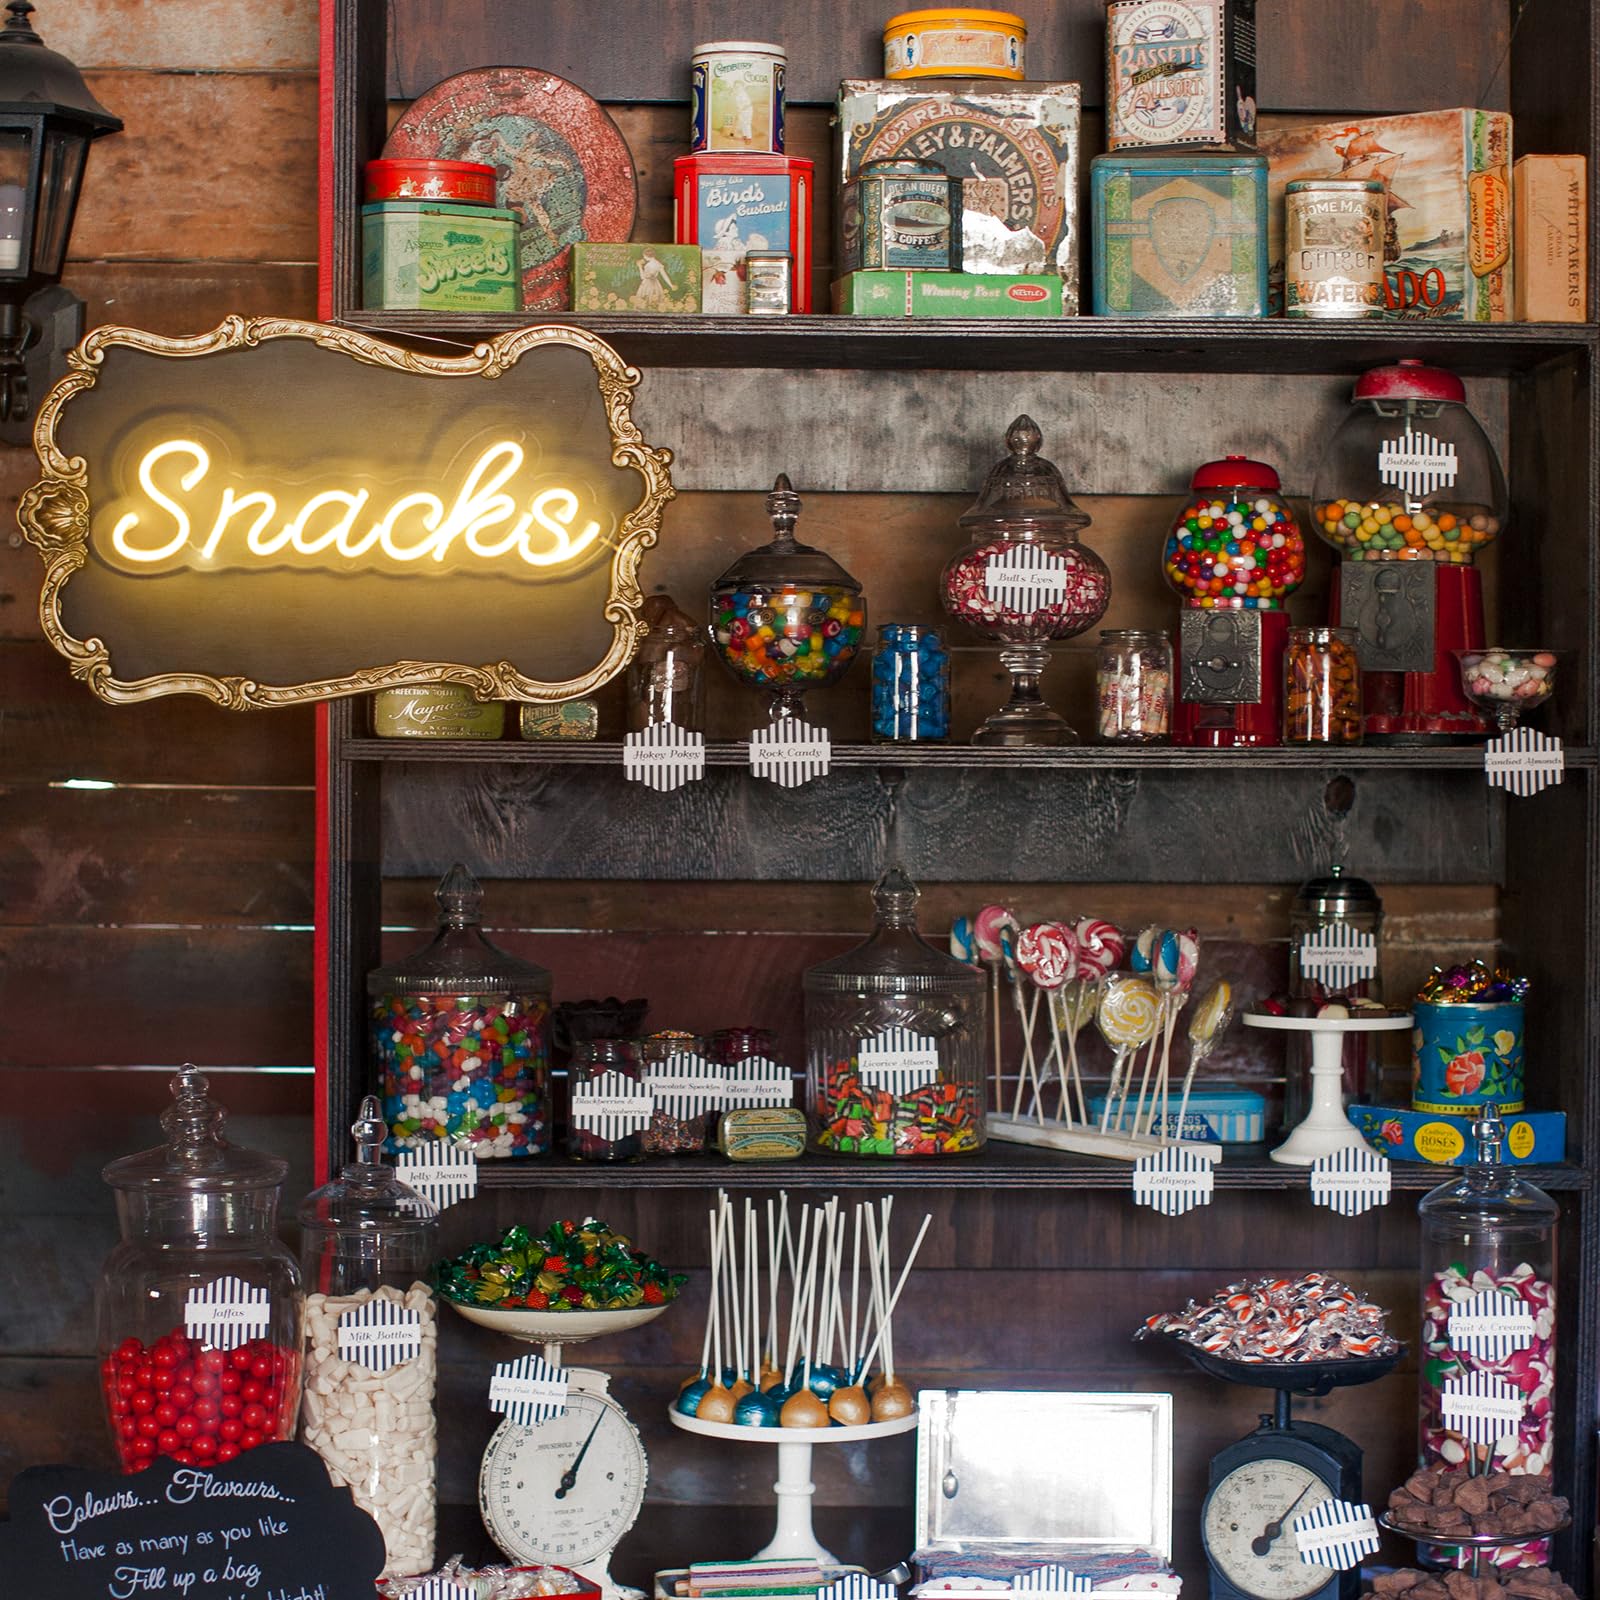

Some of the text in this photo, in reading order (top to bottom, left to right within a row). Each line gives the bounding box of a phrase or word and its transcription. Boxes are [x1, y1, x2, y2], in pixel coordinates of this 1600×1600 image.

[949, 125, 965, 148] &
[967, 127, 1034, 222] PALMERS
[706, 182, 764, 208] Bird's
[888, 182, 948, 195] OCEAN QUEEN
[736, 201, 788, 217] Custard!
[899, 234, 938, 246] COFFEE
[1567, 180, 1580, 308] WHITTAKERS
[416, 239, 510, 294] Sweets
[1301, 248, 1375, 272] Ginger
[921, 283, 1000, 300] Winning Post
[1296, 281, 1379, 304] WAFERS
[1385, 456, 1420, 466] Bubble
[111, 438, 602, 567] Snacks
[1030, 574, 1054, 585] Eyes
[633, 750, 701, 760] Hokey Pokey
[758, 747, 823, 759] Rock Candy
[862, 1059, 898, 1068] Licorice
[725, 1085, 750, 1094] Glow
[1421, 1135, 1457, 1147] ROSES
[410, 1171, 469, 1182] Jelly Beans
[1149, 1176, 1197, 1187] Lollipops
[212, 1308, 246, 1319] Jaffas
[1449, 1322, 1532, 1333] Fruit & Creams
[348, 1330, 415, 1343] Milk Bottles
[43, 1468, 296, 1534] Colours... Flavours...
[60, 1517, 289, 1562] Have as many as you like
[108, 1556, 262, 1599] Fill up a bag
